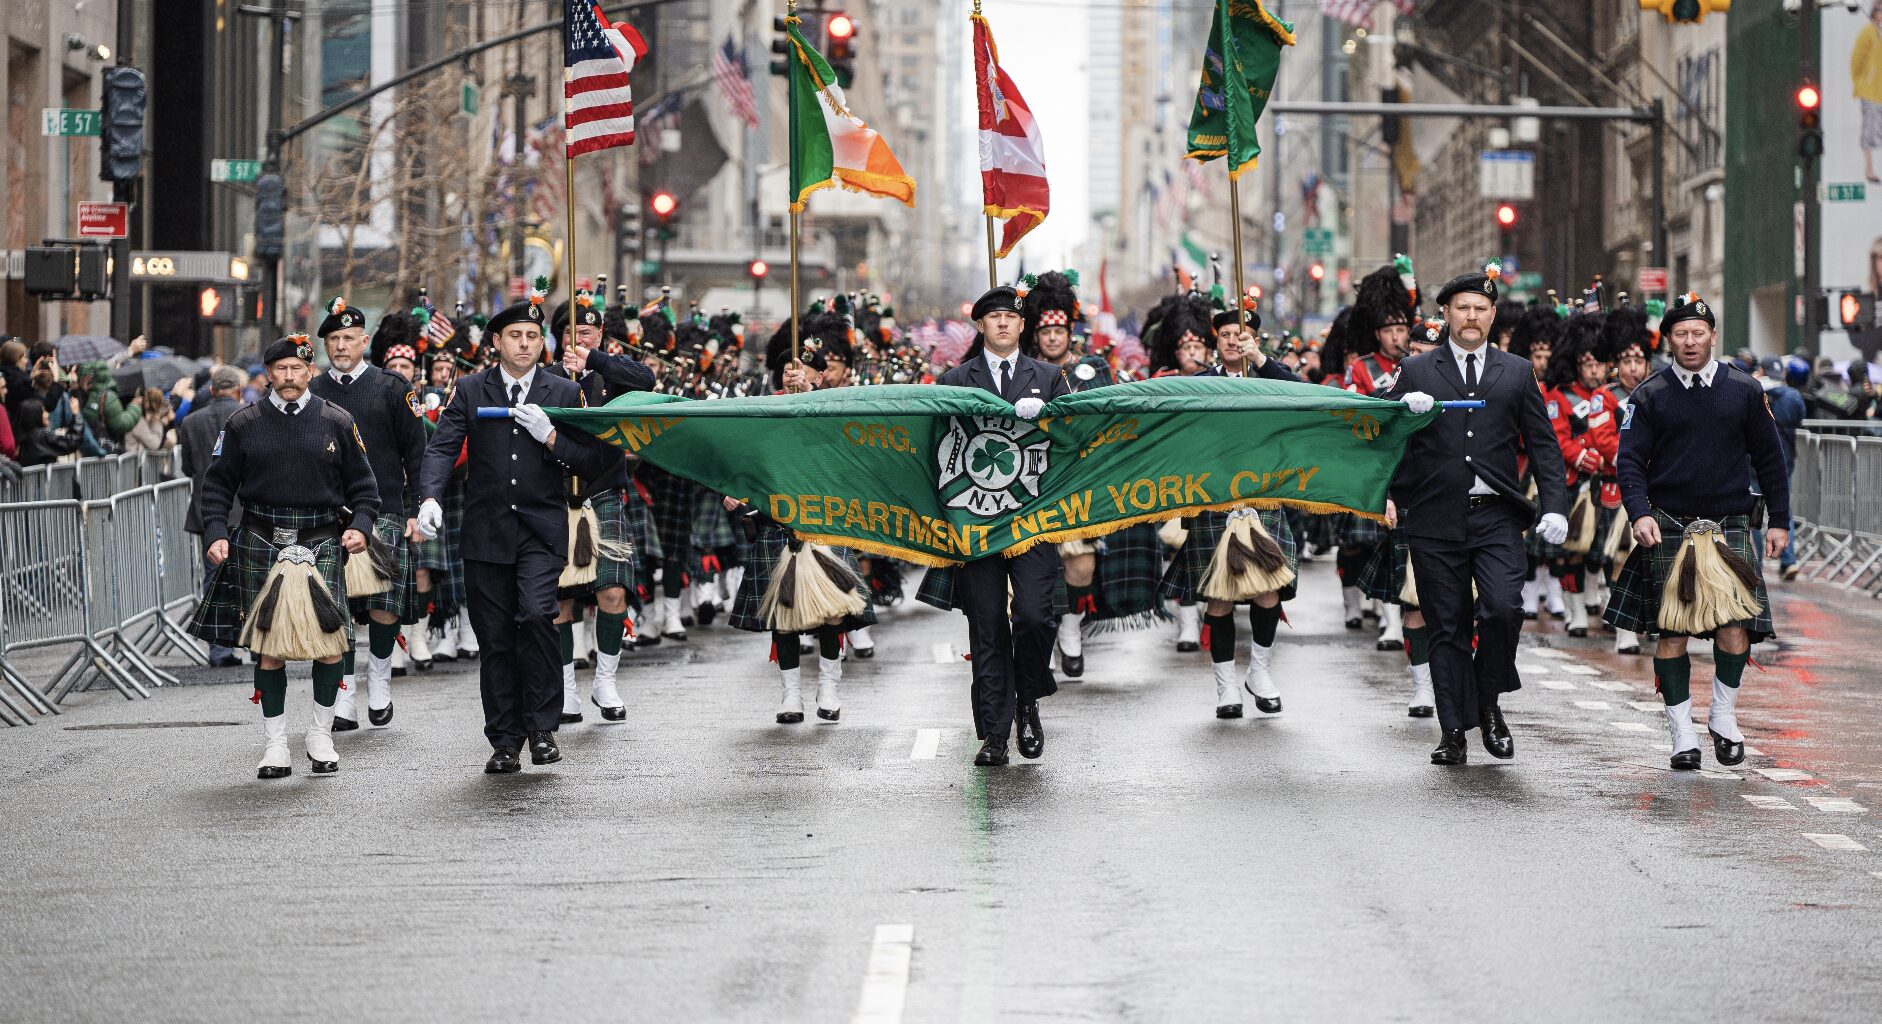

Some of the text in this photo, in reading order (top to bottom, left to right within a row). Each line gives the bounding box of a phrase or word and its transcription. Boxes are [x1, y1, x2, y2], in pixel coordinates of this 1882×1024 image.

[60, 113, 69, 133] E
[75, 113, 92, 133] 57
[132, 257, 146, 275] &
[844, 421, 917, 454] ORG.
[769, 466, 1320, 556] DEPARTMENT NEW YORK CITY
[968, 489, 1009, 512] N.Y.
